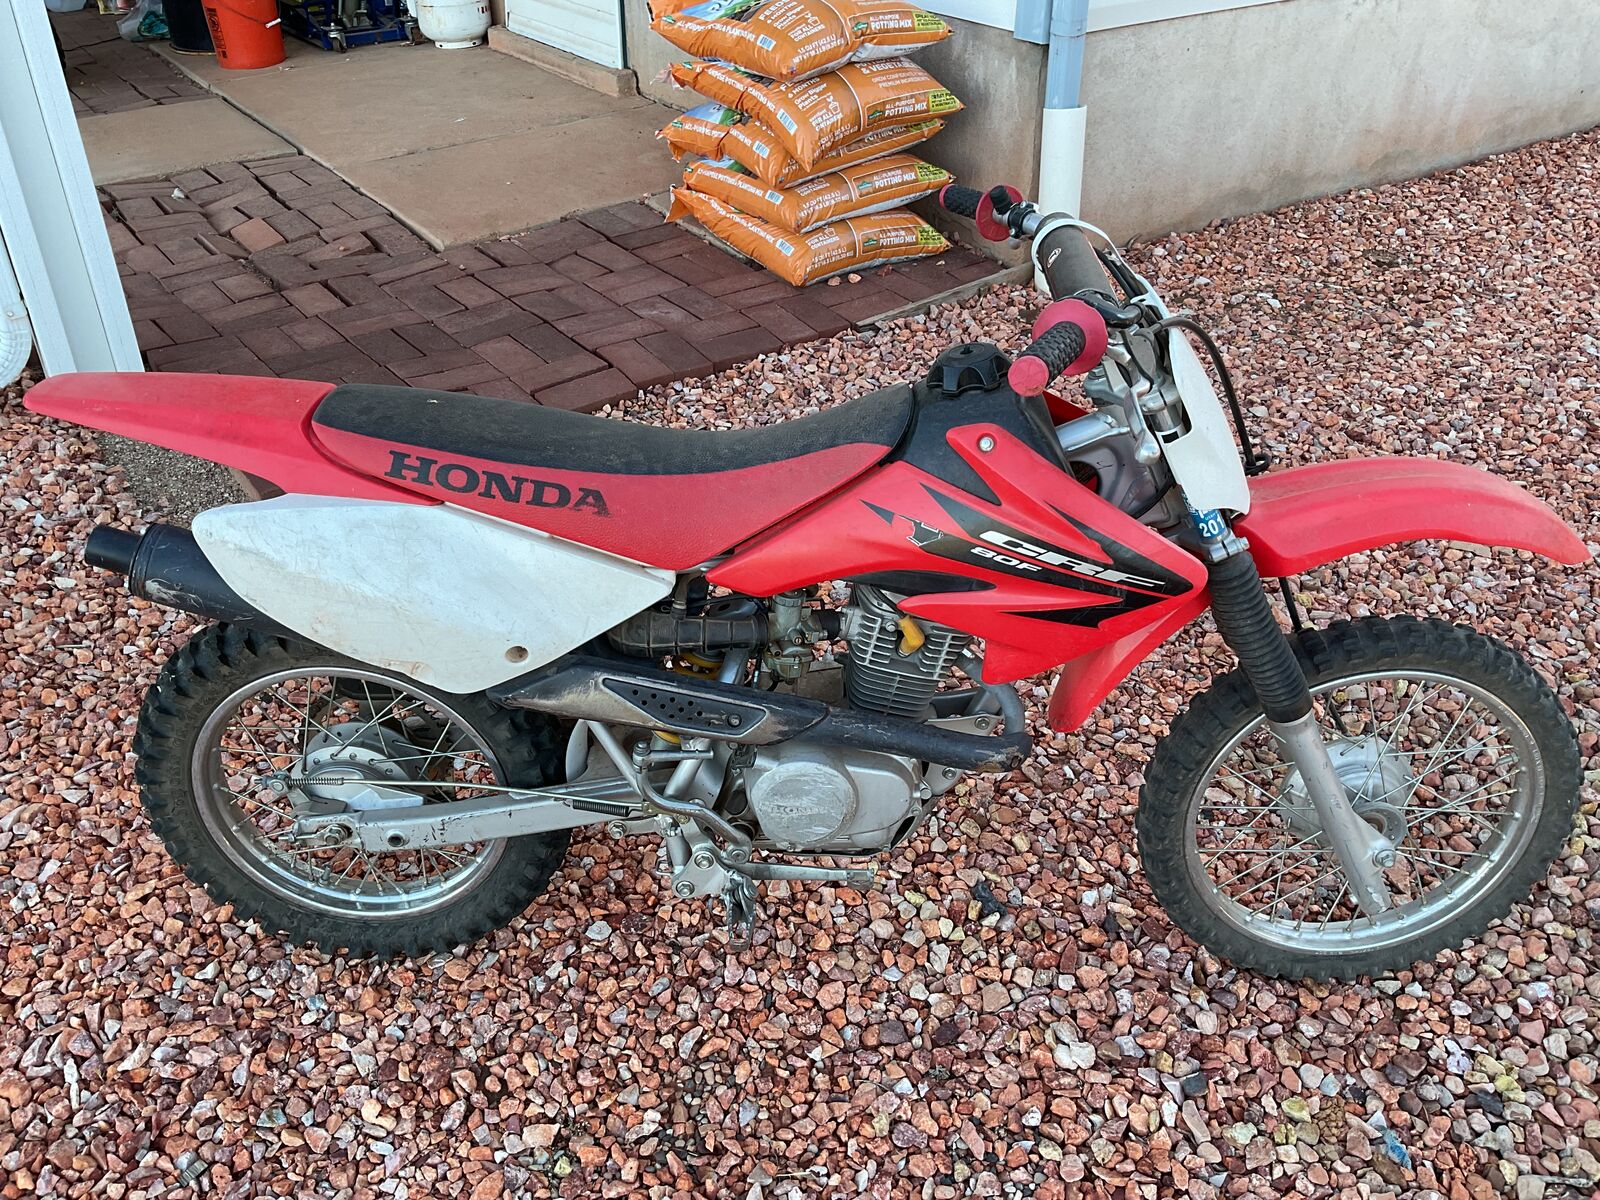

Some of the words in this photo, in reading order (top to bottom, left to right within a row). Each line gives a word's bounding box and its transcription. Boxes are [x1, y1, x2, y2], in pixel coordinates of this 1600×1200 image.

[758, 0, 789, 20] FEED
[802, 24, 815, 33] ALL
[871, 19, 899, 30] POTTING
[899, 18, 913, 28] MIX
[861, 66, 871, 75] &
[792, 77, 821, 95] MONTHS
[794, 92, 810, 105] Grow
[808, 82, 828, 95] Bigger
[797, 94, 819, 110] Plants
[884, 105, 914, 118] POTTING
[914, 101, 928, 112] MIX
[885, 98, 916, 109] ALL-PURPOSE
[821, 111, 834, 121] ALL
[864, 130, 893, 143] POTTING
[892, 125, 907, 135] MIX
[874, 175, 903, 189] POTTING
[902, 171, 917, 182] MIX
[879, 236, 905, 247] POTTING
[904, 234, 917, 244] MIX
[384, 450, 613, 517] HONDA
[970, 546, 1042, 573] 80F
[979, 530, 1166, 587] CRF
